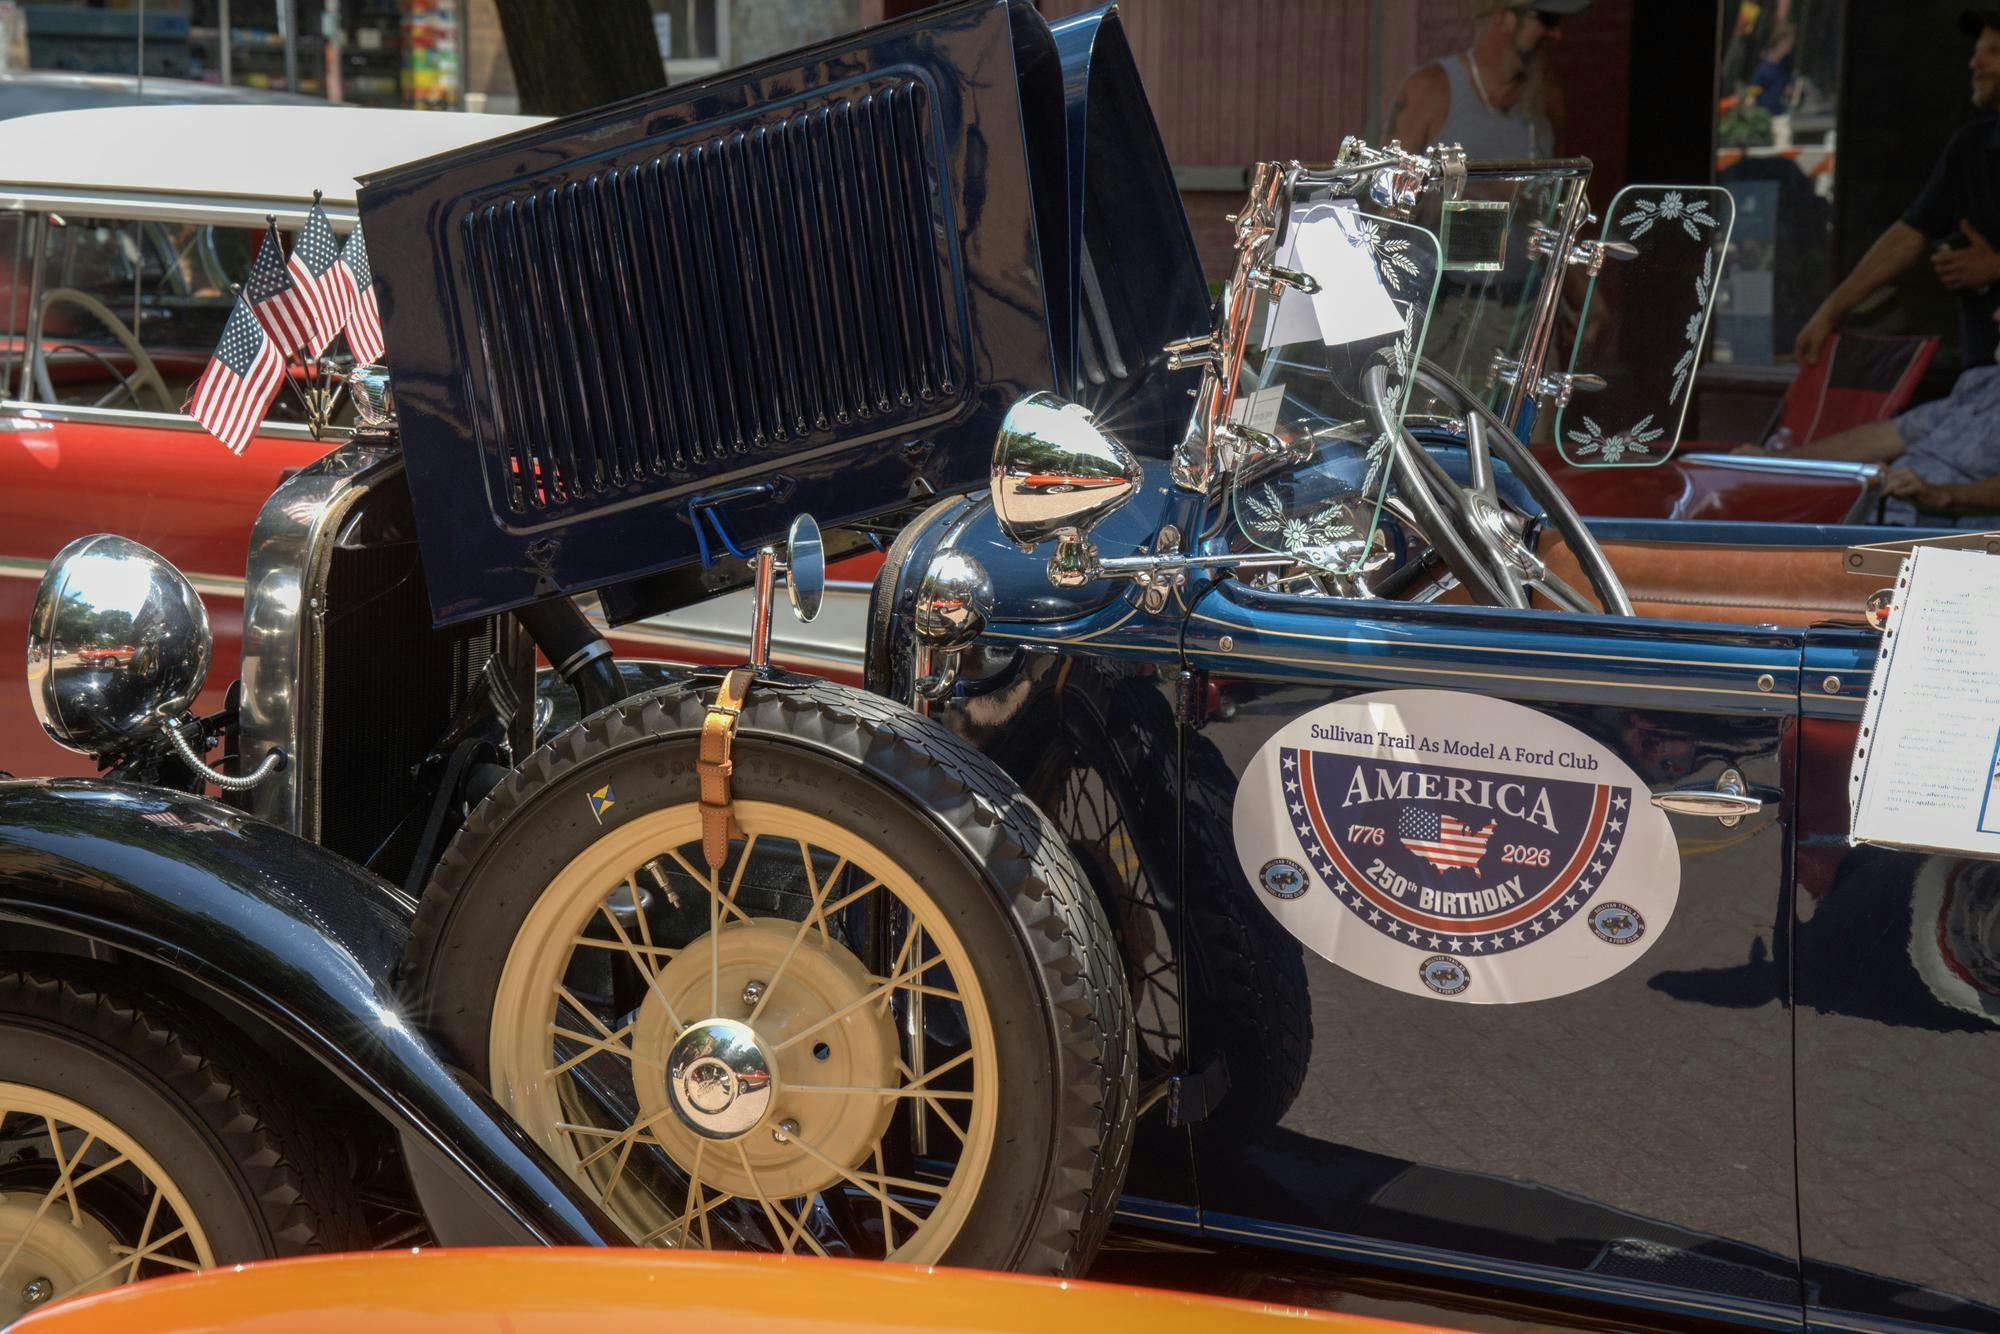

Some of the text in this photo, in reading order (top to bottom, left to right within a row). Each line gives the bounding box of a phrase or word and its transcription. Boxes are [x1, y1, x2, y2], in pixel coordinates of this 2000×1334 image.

[1311, 724, 1599, 771] Sullivan Trail As Model A Ford Club
[1341, 765, 1560, 834] AMERICA
[1347, 824, 1386, 846] 1776
[1501, 844, 1551, 868] 2026
[1365, 858, 1526, 915] 250th BIRTHDAY
